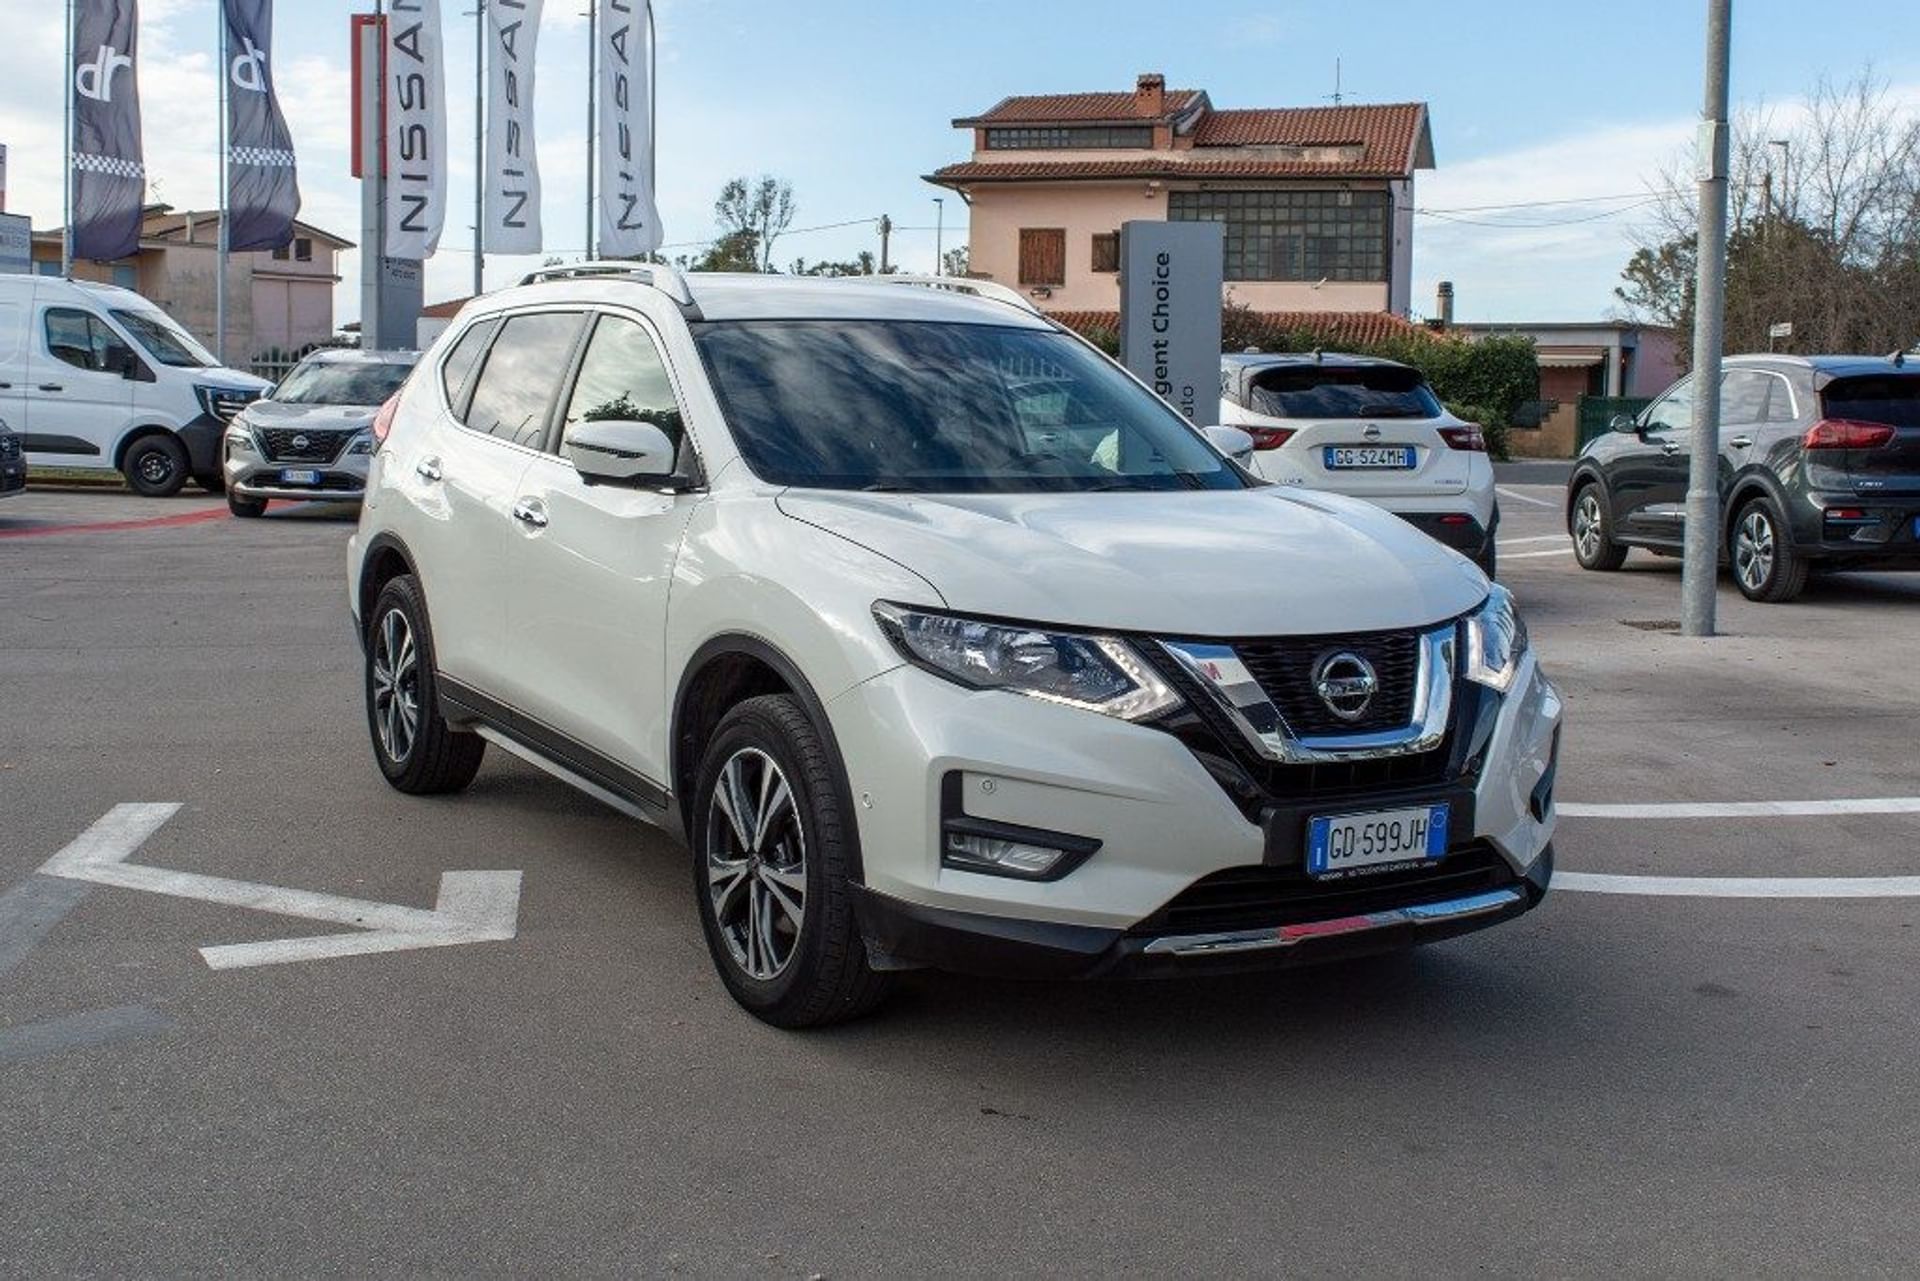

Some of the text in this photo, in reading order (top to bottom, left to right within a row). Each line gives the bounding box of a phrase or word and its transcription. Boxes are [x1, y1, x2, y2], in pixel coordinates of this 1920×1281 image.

[500, 0, 528, 228] NISSA
[1152, 252, 1173, 400] gent Choice
[1362, 818, 1428, 855] 599JH
